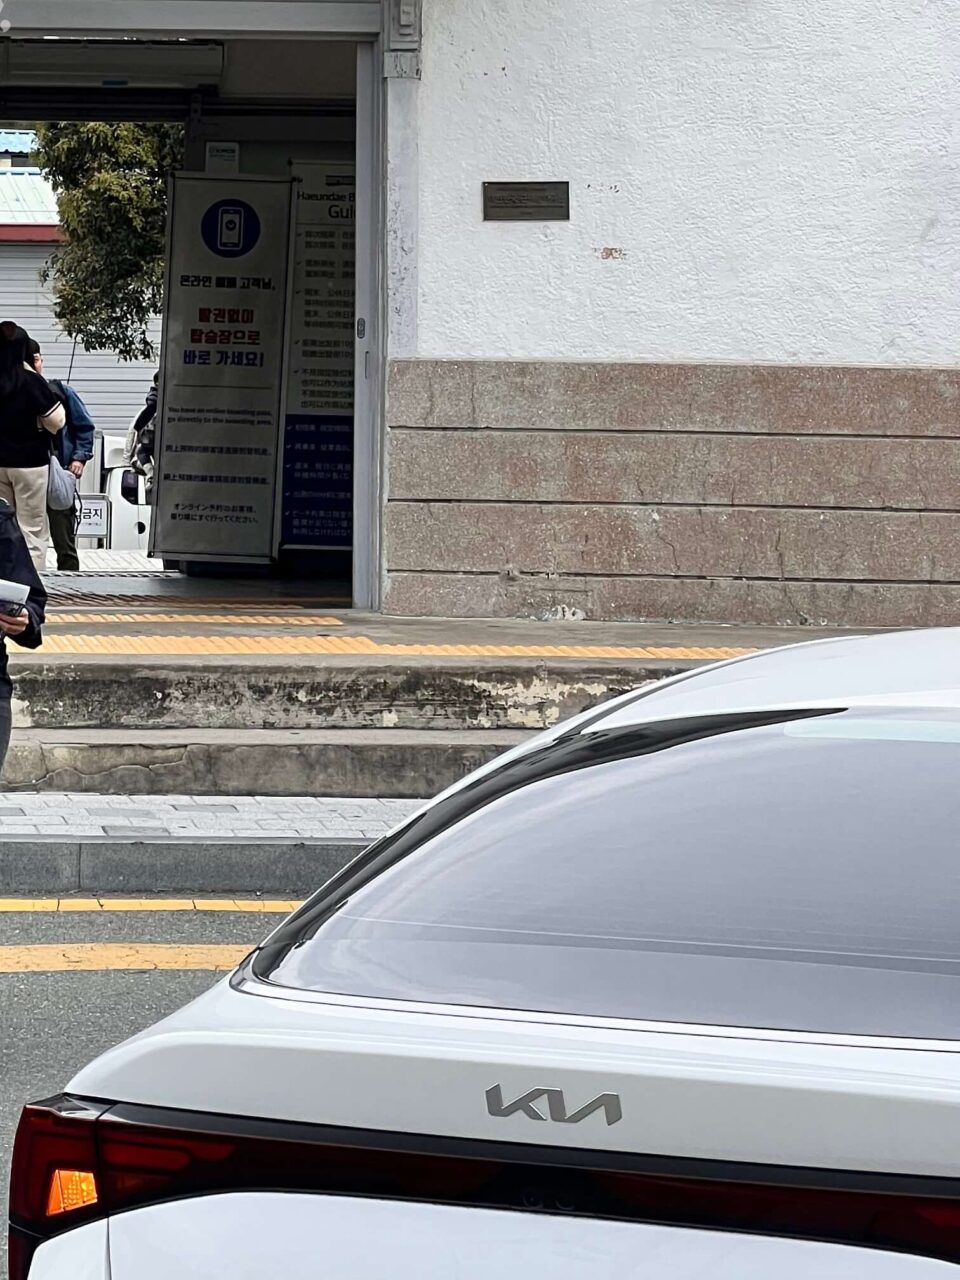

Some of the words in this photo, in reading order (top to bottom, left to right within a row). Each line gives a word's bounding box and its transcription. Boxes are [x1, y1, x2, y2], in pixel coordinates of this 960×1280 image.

[297, 191, 346, 201] Haeundae
[180, 275, 213, 288] 온라인
[184, 350, 211, 365] 바로
[216, 350, 265, 367] 가세요!
[81, 508, 103, 520] 금지
